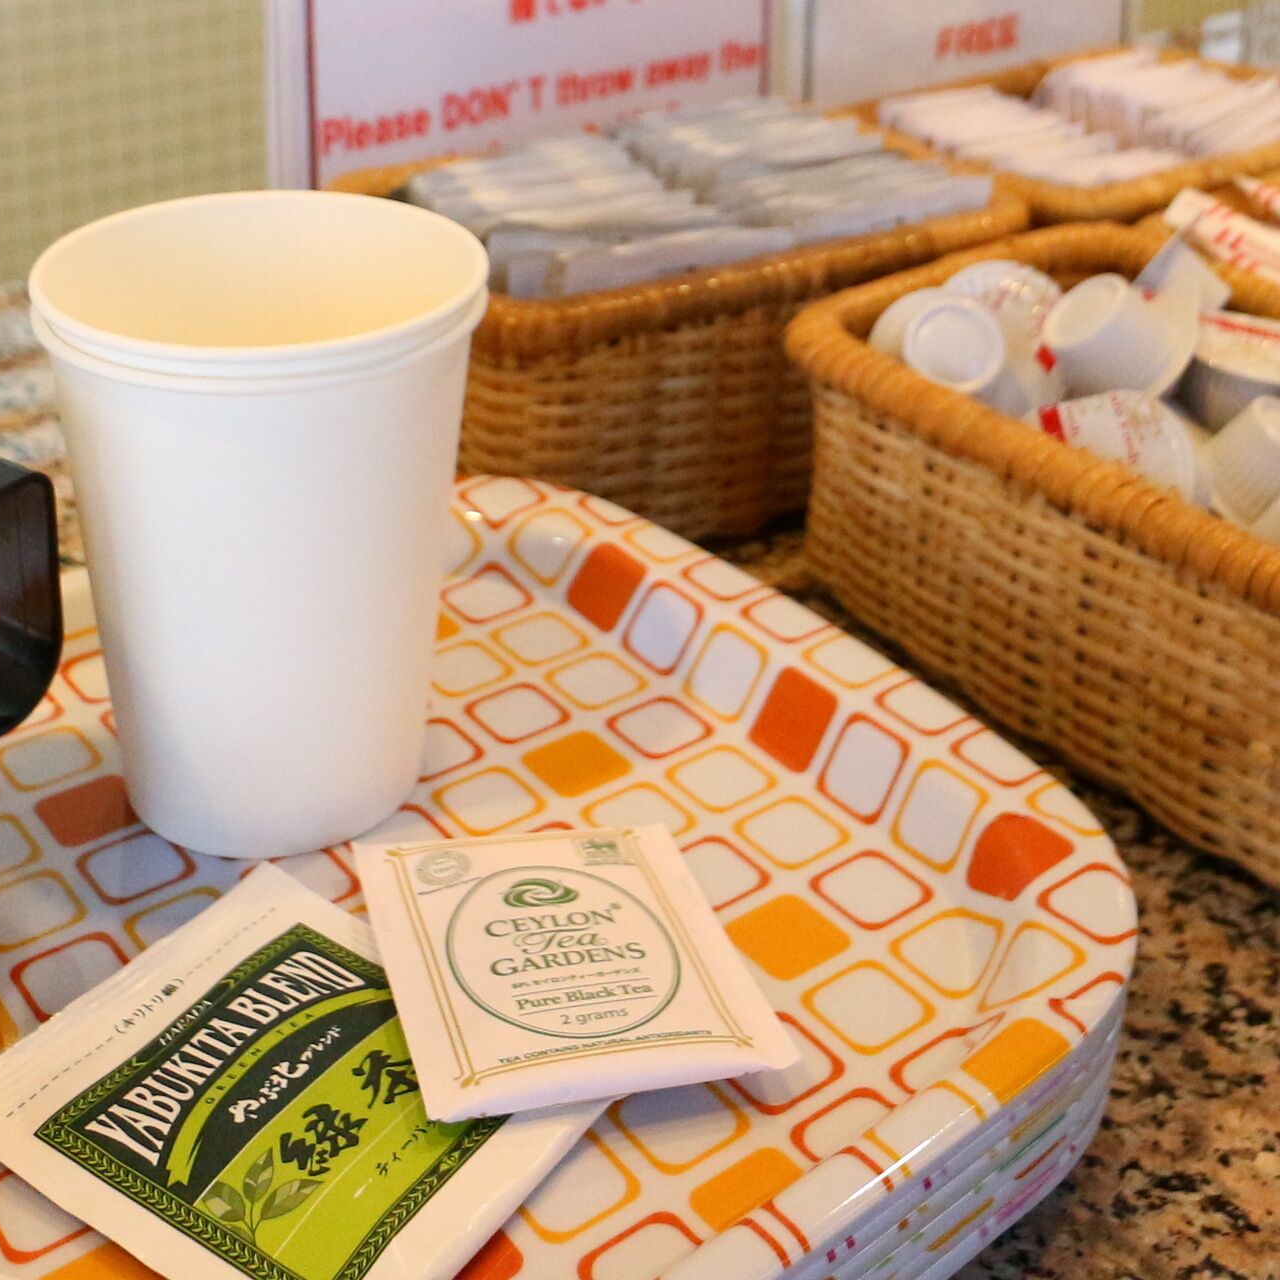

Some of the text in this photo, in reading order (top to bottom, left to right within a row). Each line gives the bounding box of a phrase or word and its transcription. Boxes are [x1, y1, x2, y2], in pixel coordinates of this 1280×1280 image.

[935, 11, 1018, 61] FREE
[322, 108, 430, 156] Please
[557, 67, 633, 106] throw
[490, 942, 647, 977] GARDENS
[514, 931, 608, 956] Tea
[516, 982, 654, 1012] Pure Black Tea
[560, 1007, 629, 1025] 2 grams
[159, 999, 214, 1047] HARADA
[84, 951, 366, 1167] YABUKITA BLEND
[205, 1011, 315, 1105] GREEN TEA
[498, 1055, 521, 1065] TEA
